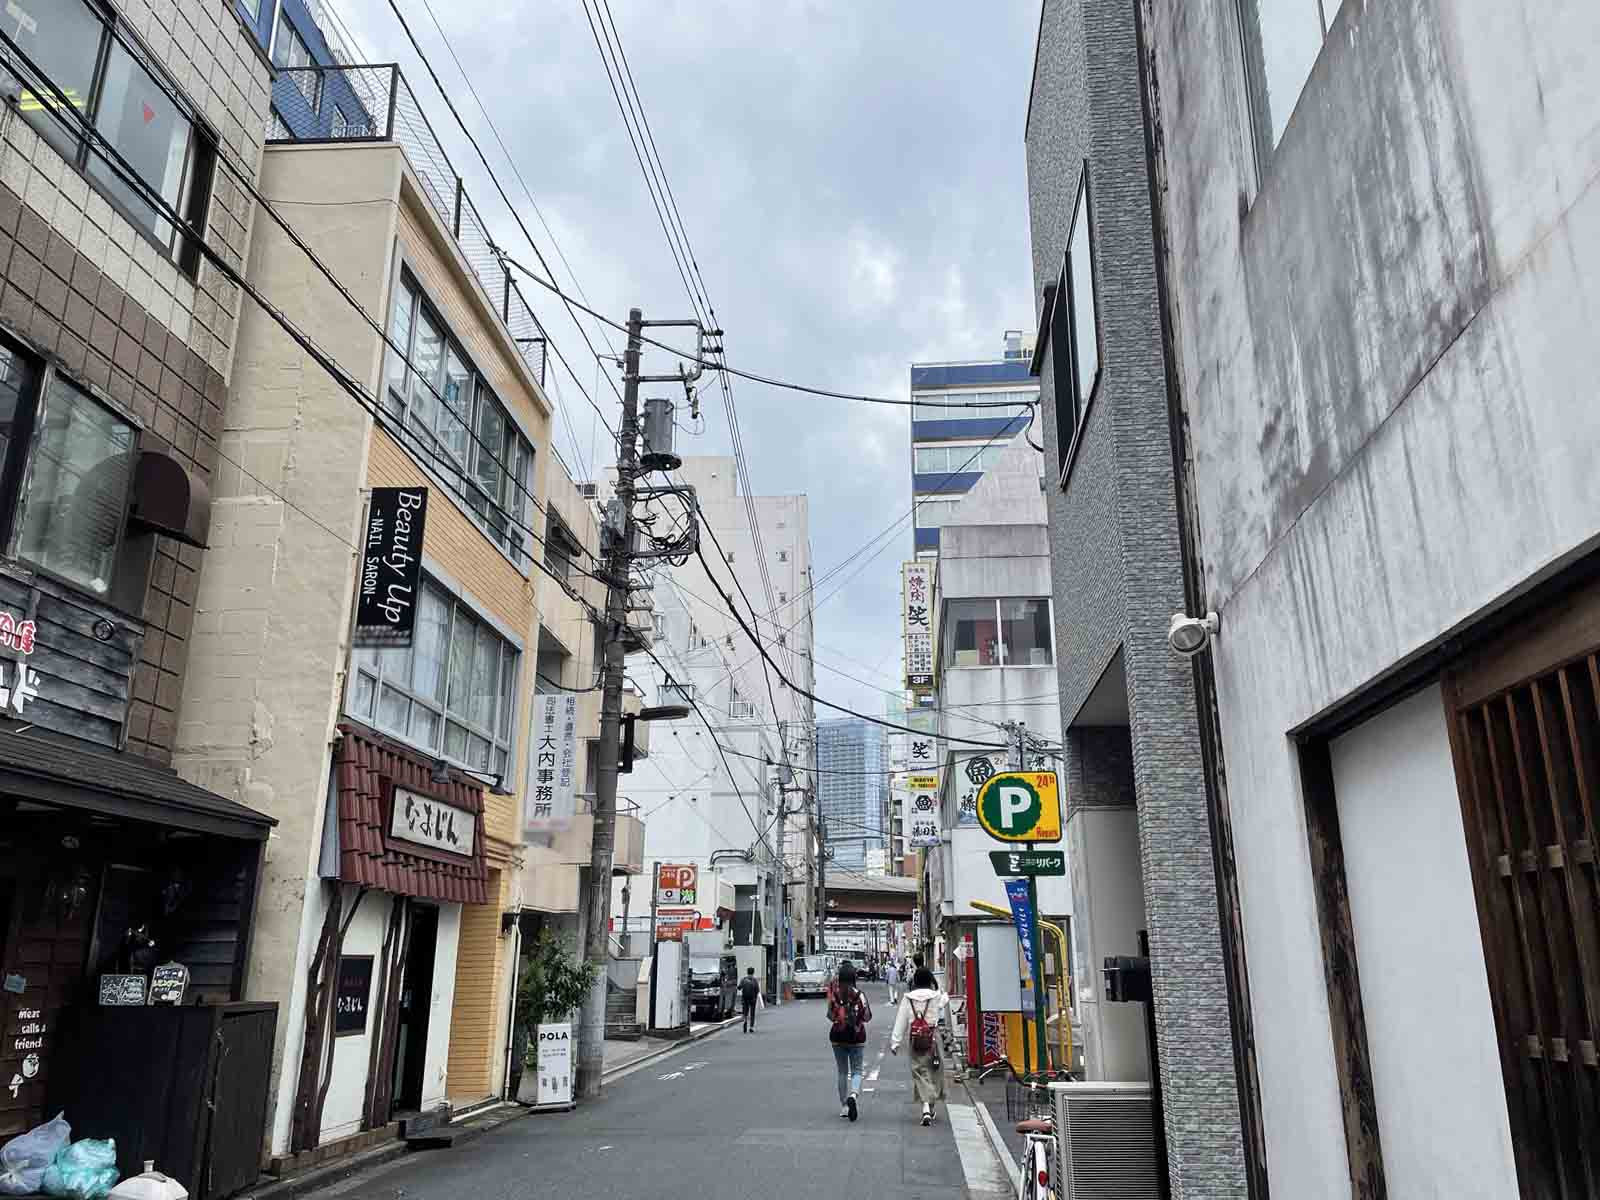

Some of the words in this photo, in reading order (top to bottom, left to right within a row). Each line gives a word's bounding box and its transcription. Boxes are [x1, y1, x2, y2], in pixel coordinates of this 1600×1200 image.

[380, 492, 422, 577] Beauty
[376, 584, 413, 624] Up
[912, 676, 929, 685] 3F
[912, 742, 930, 759] 笑
[1000, 787, 1032, 828] P
[677, 867, 695, 887] P
[540, 1032, 569, 1041] POLA
